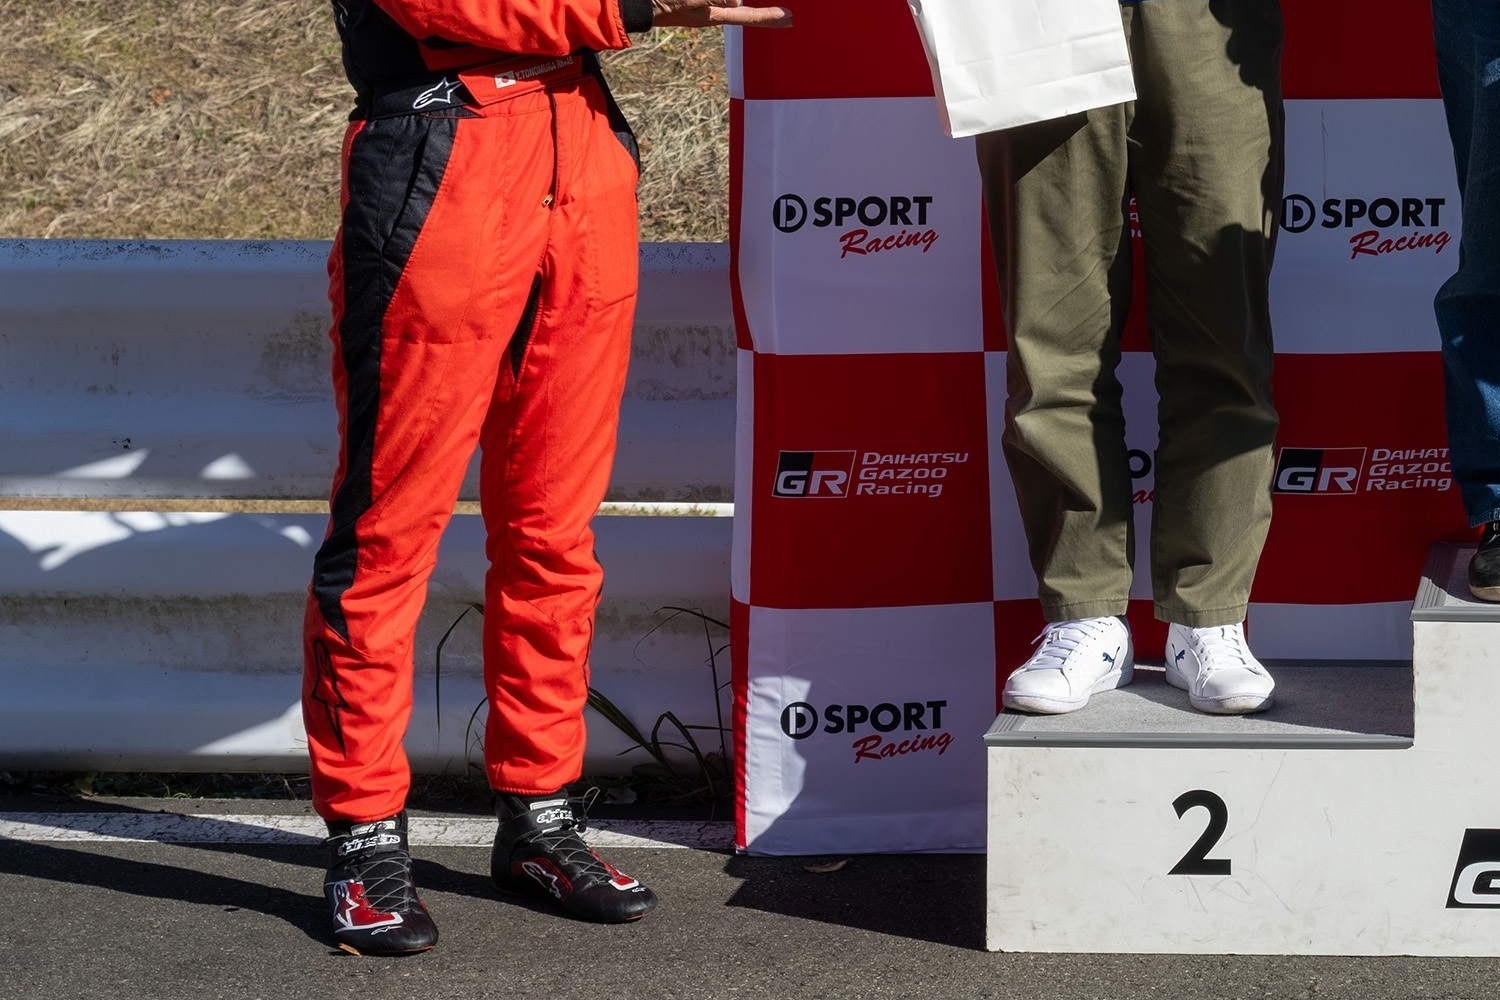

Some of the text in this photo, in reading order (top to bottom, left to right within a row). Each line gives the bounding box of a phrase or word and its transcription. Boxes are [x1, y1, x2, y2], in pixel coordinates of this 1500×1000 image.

[812, 196, 933, 227] SPORT
[1322, 198, 1445, 229] SPORT
[839, 228, 939, 259] Racing
[1349, 229, 1452, 260] Racing
[861, 452, 969, 465] DAIHATSU
[1371, 447, 1449, 460] DAIHAT
[776, 470, 853, 495] GR
[859, 467, 947, 480] GAZOO
[1278, 467, 1356, 493] GR
[1365, 475, 1452, 491] Racing
[856, 481, 943, 498] Racing
[824, 701, 947, 733] SPORT
[853, 732, 954, 764] Racing
[1167, 789, 1232, 876] 2
